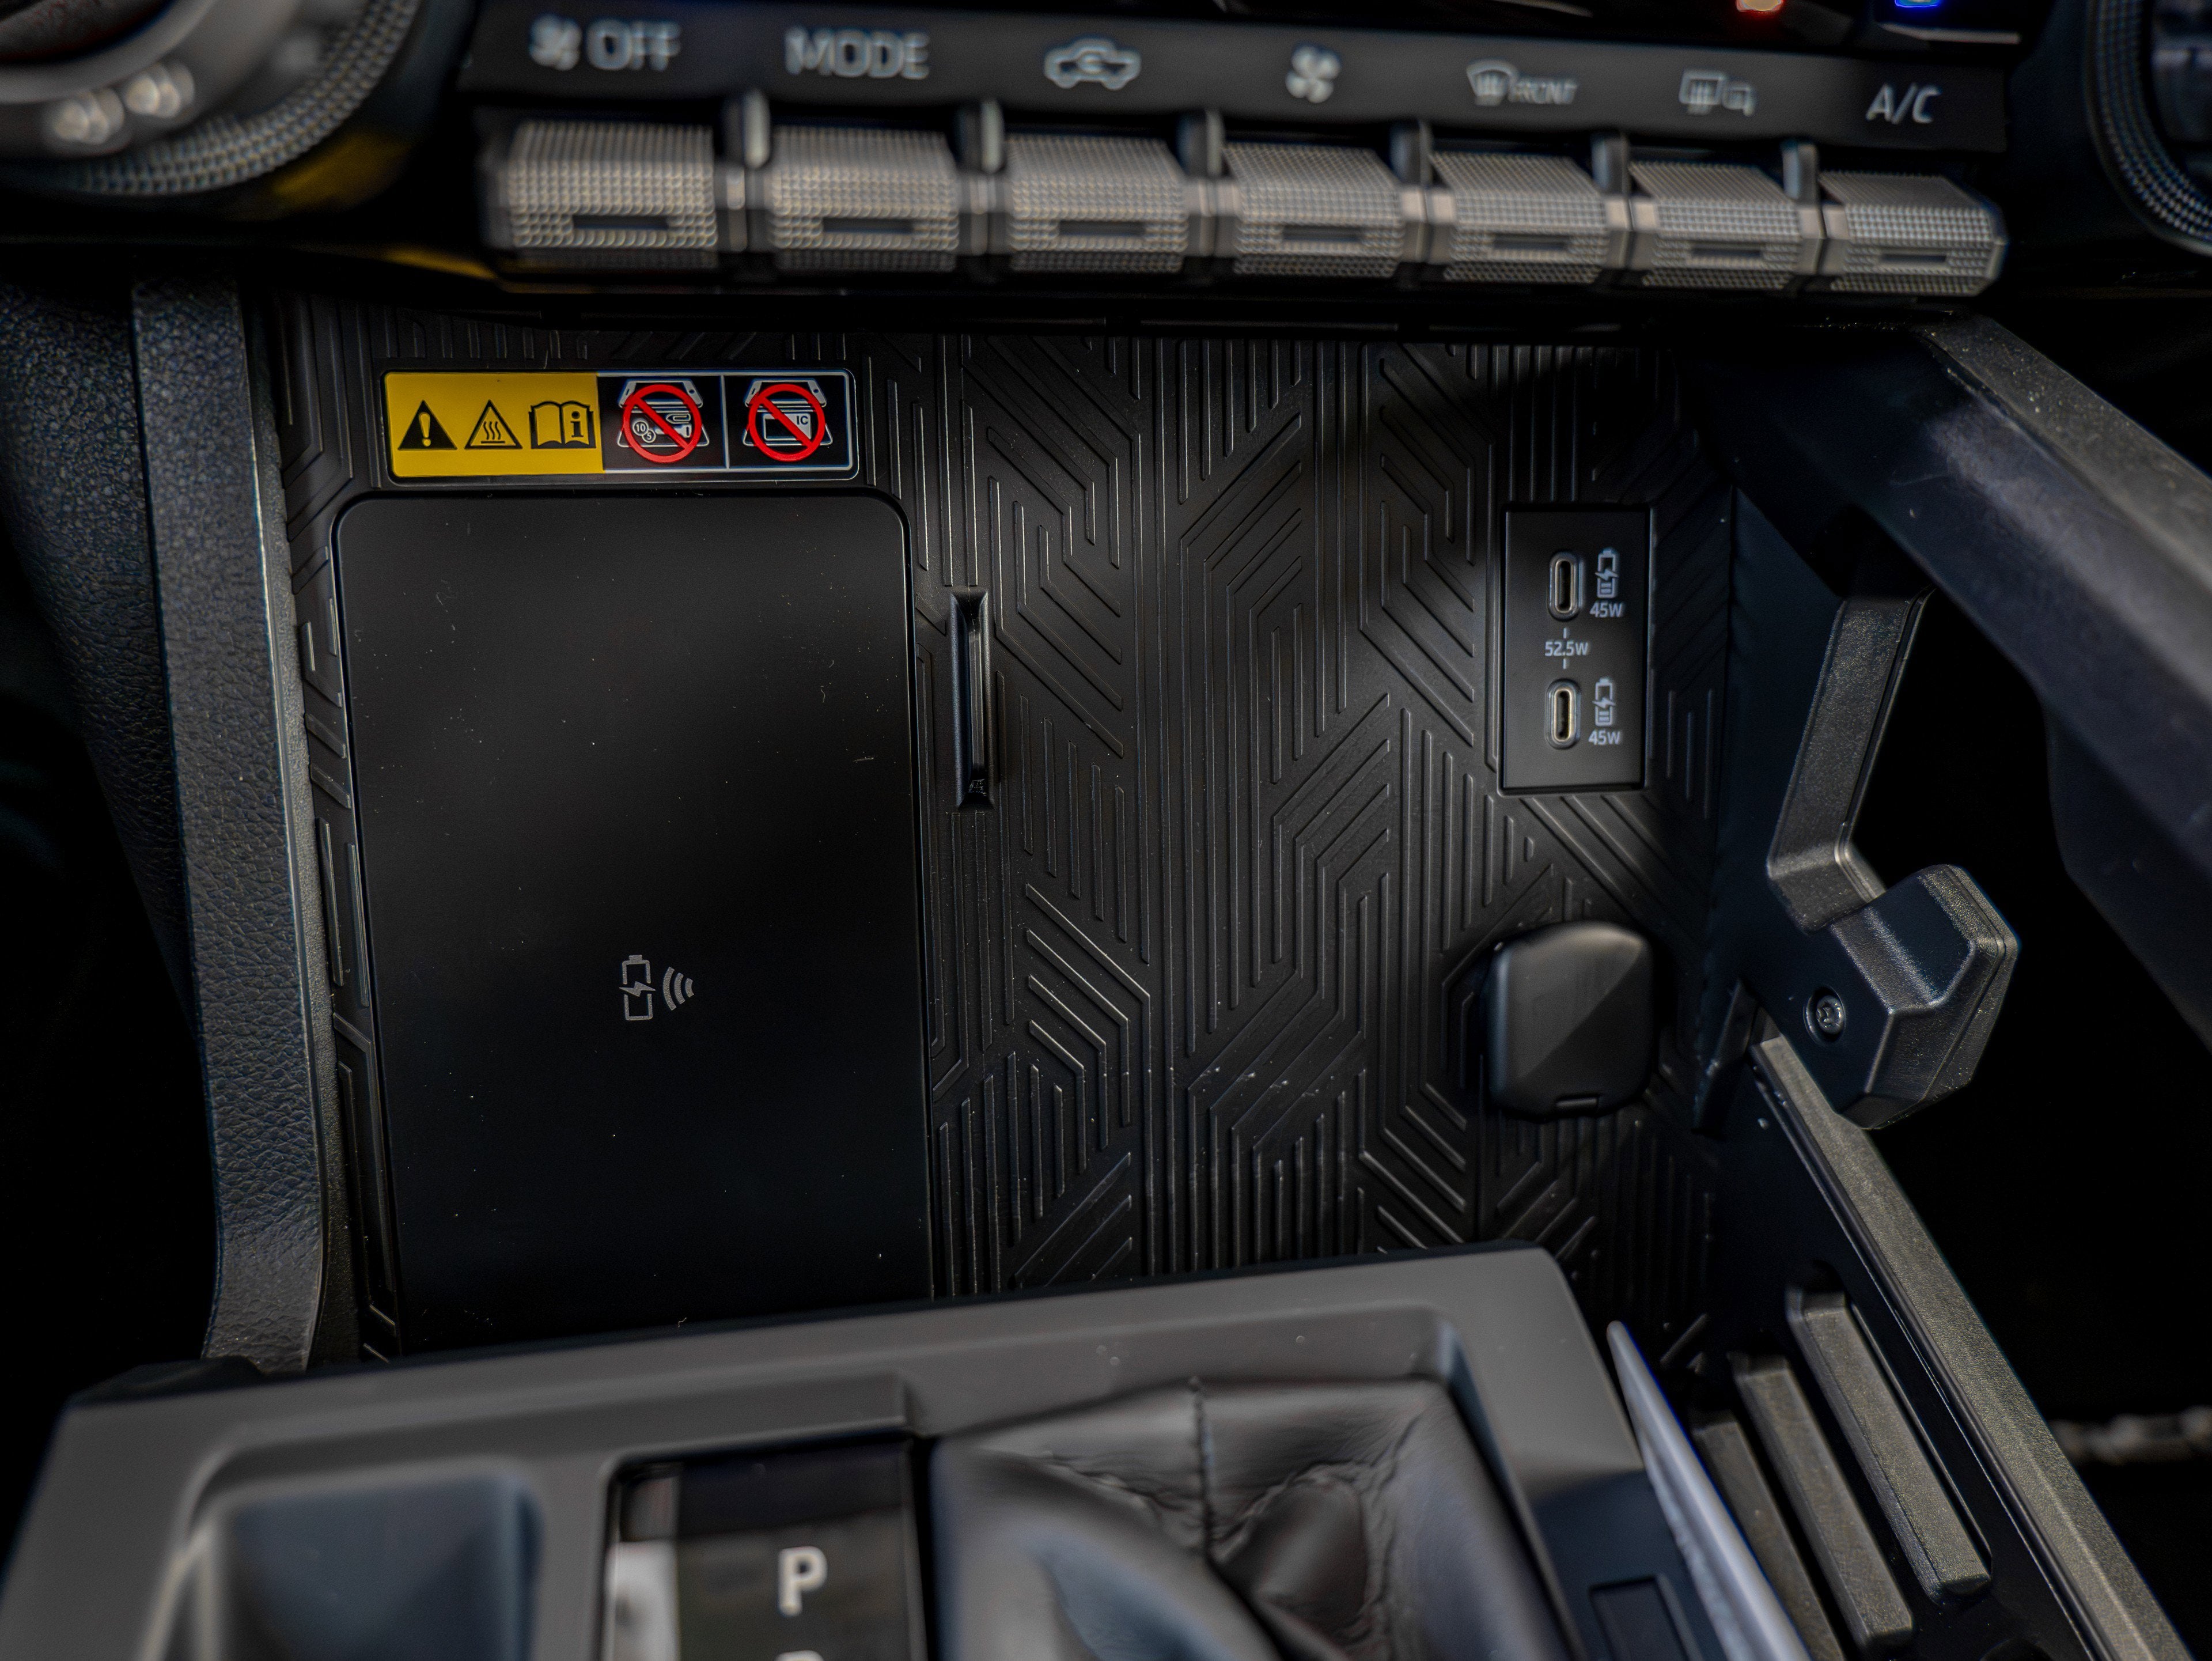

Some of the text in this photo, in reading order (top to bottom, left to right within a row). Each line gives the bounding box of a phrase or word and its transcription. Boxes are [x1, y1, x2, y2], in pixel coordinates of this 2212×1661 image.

[586, 18, 681, 71] OFF
[784, 26, 930, 80] MODE
[1865, 82, 1942, 124] A/C
[636, 423, 646, 432] 10
[796, 415, 808, 425] IC
[647, 432, 652, 440] 5
[1589, 601, 1624, 618] 45W
[1545, 640, 1589, 657] 52.5W
[1588, 729, 1621, 746] 45W
[778, 1546, 828, 1616] P
